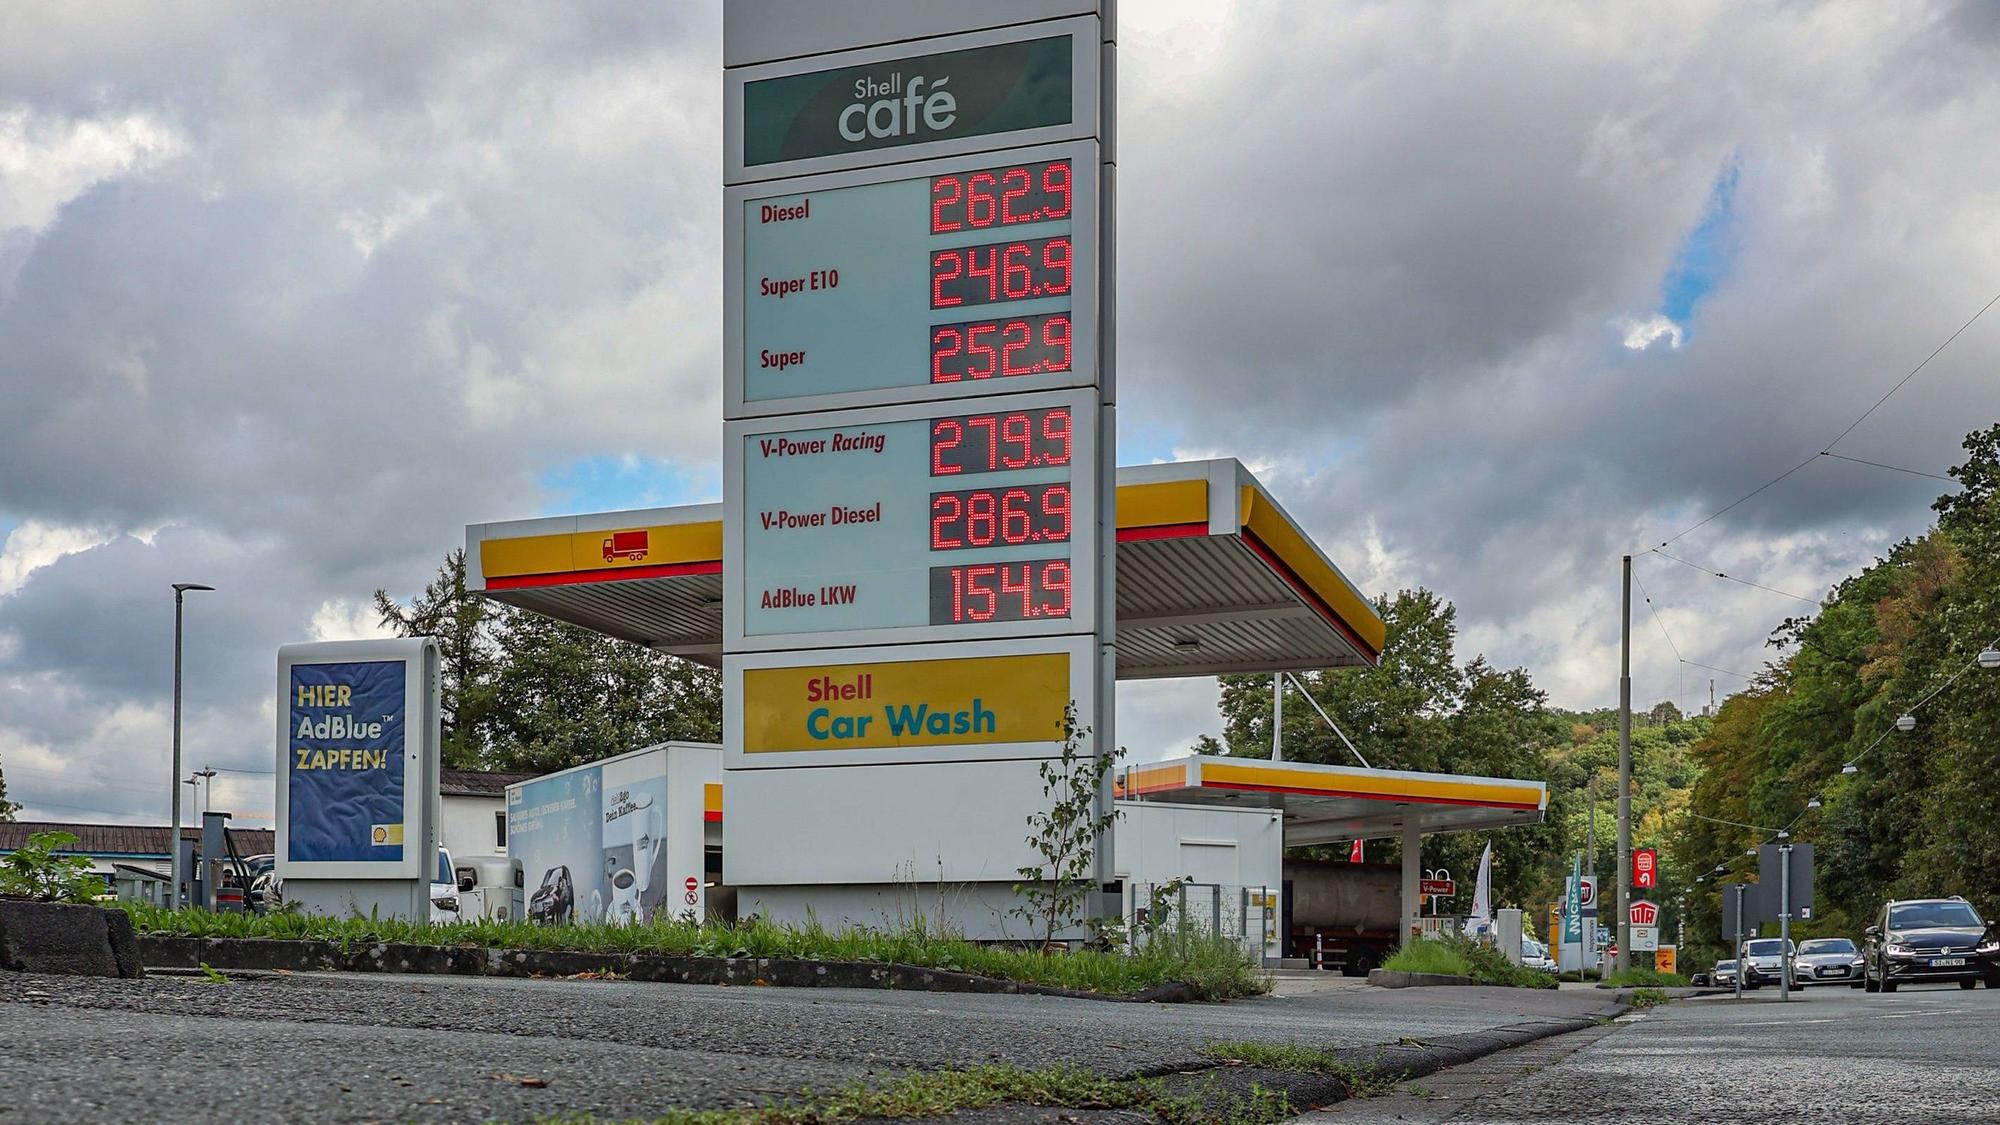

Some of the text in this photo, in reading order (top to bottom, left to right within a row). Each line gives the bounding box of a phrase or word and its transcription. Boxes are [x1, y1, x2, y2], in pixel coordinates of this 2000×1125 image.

[838, 75, 957, 142] café
[854, 73, 901, 100] Shell
[761, 162, 1072, 232] Diesel 262.9
[761, 240, 1072, 306] Super E10 246.9
[761, 316, 1072, 382] Super 252.9
[761, 410, 1072, 474] V-Power Racing 279.9
[761, 487, 1071, 549] V-Power Diesel 286.9
[761, 561, 1071, 622] AdBlue LKW 154.9
[297, 685, 352, 708] HIER
[807, 674, 872, 702] Shell
[807, 698, 996, 740] Car Wash
[295, 749, 388, 770] ZAPFEN!
[1630, 903, 1656, 924] UTA
